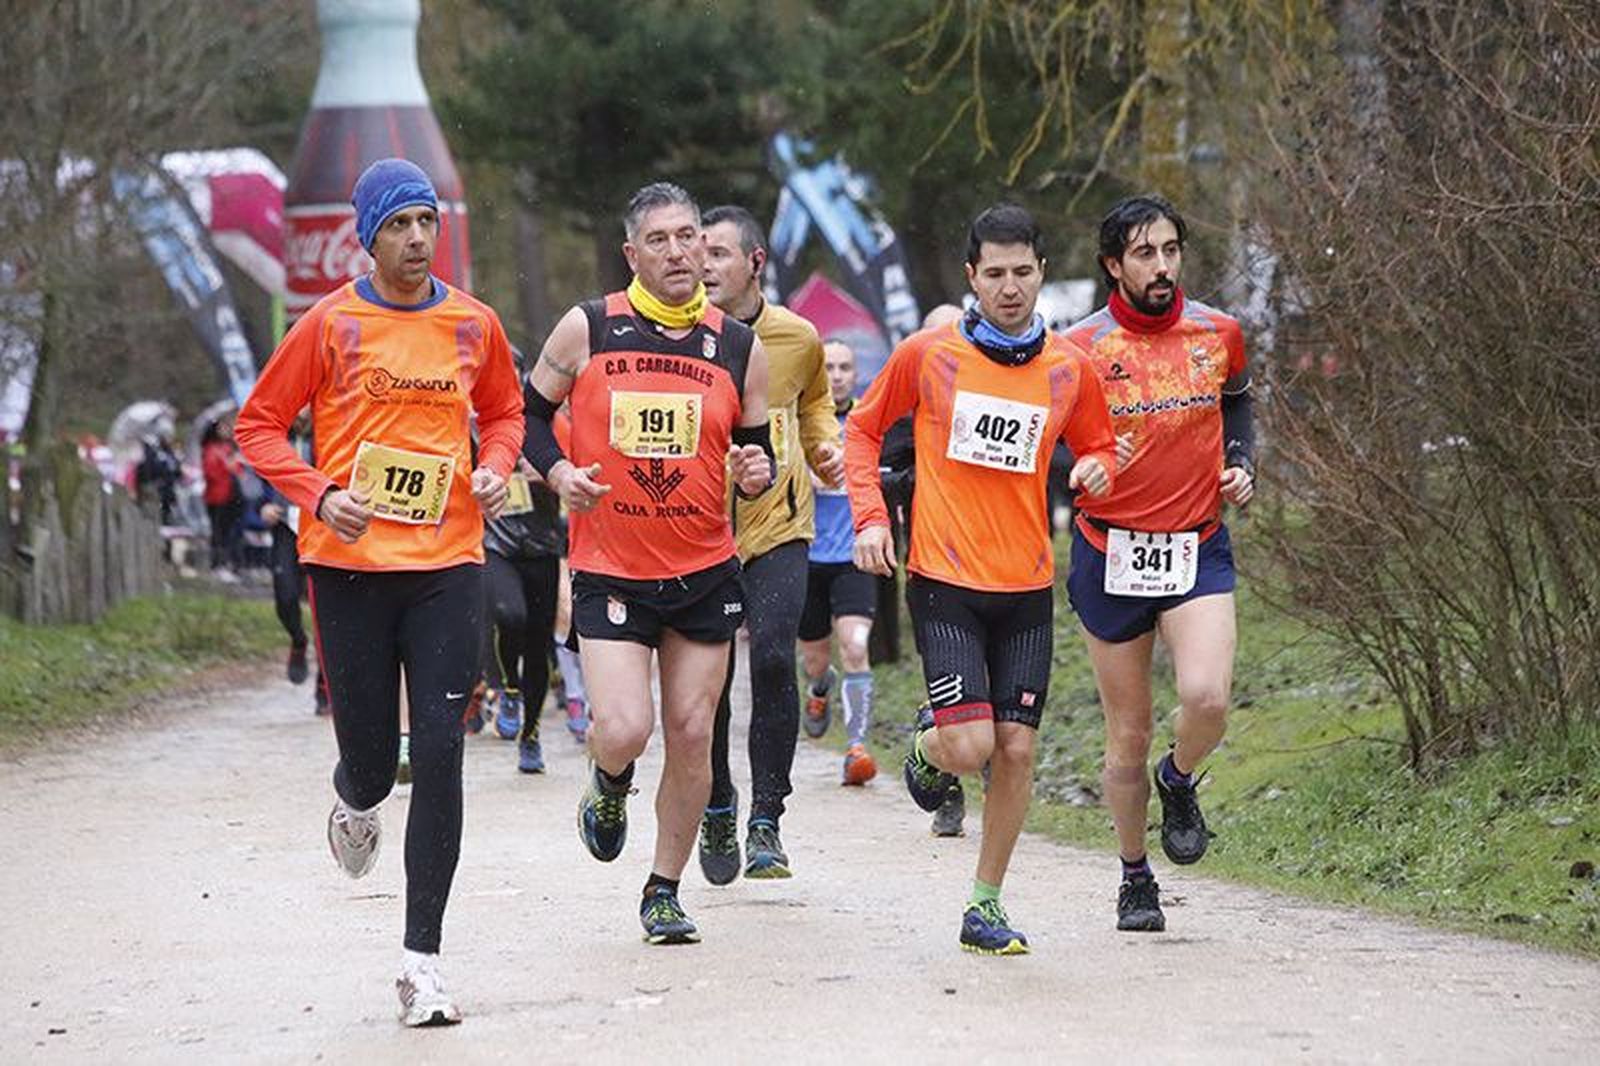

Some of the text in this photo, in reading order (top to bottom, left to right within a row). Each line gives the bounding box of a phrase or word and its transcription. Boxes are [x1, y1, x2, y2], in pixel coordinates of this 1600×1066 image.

[635, 357, 714, 387] CARBAJALES
[638, 408, 675, 433] 191
[974, 413, 1021, 445] 402
[384, 465, 426, 497] 178
[1132, 546, 1172, 573] 341
